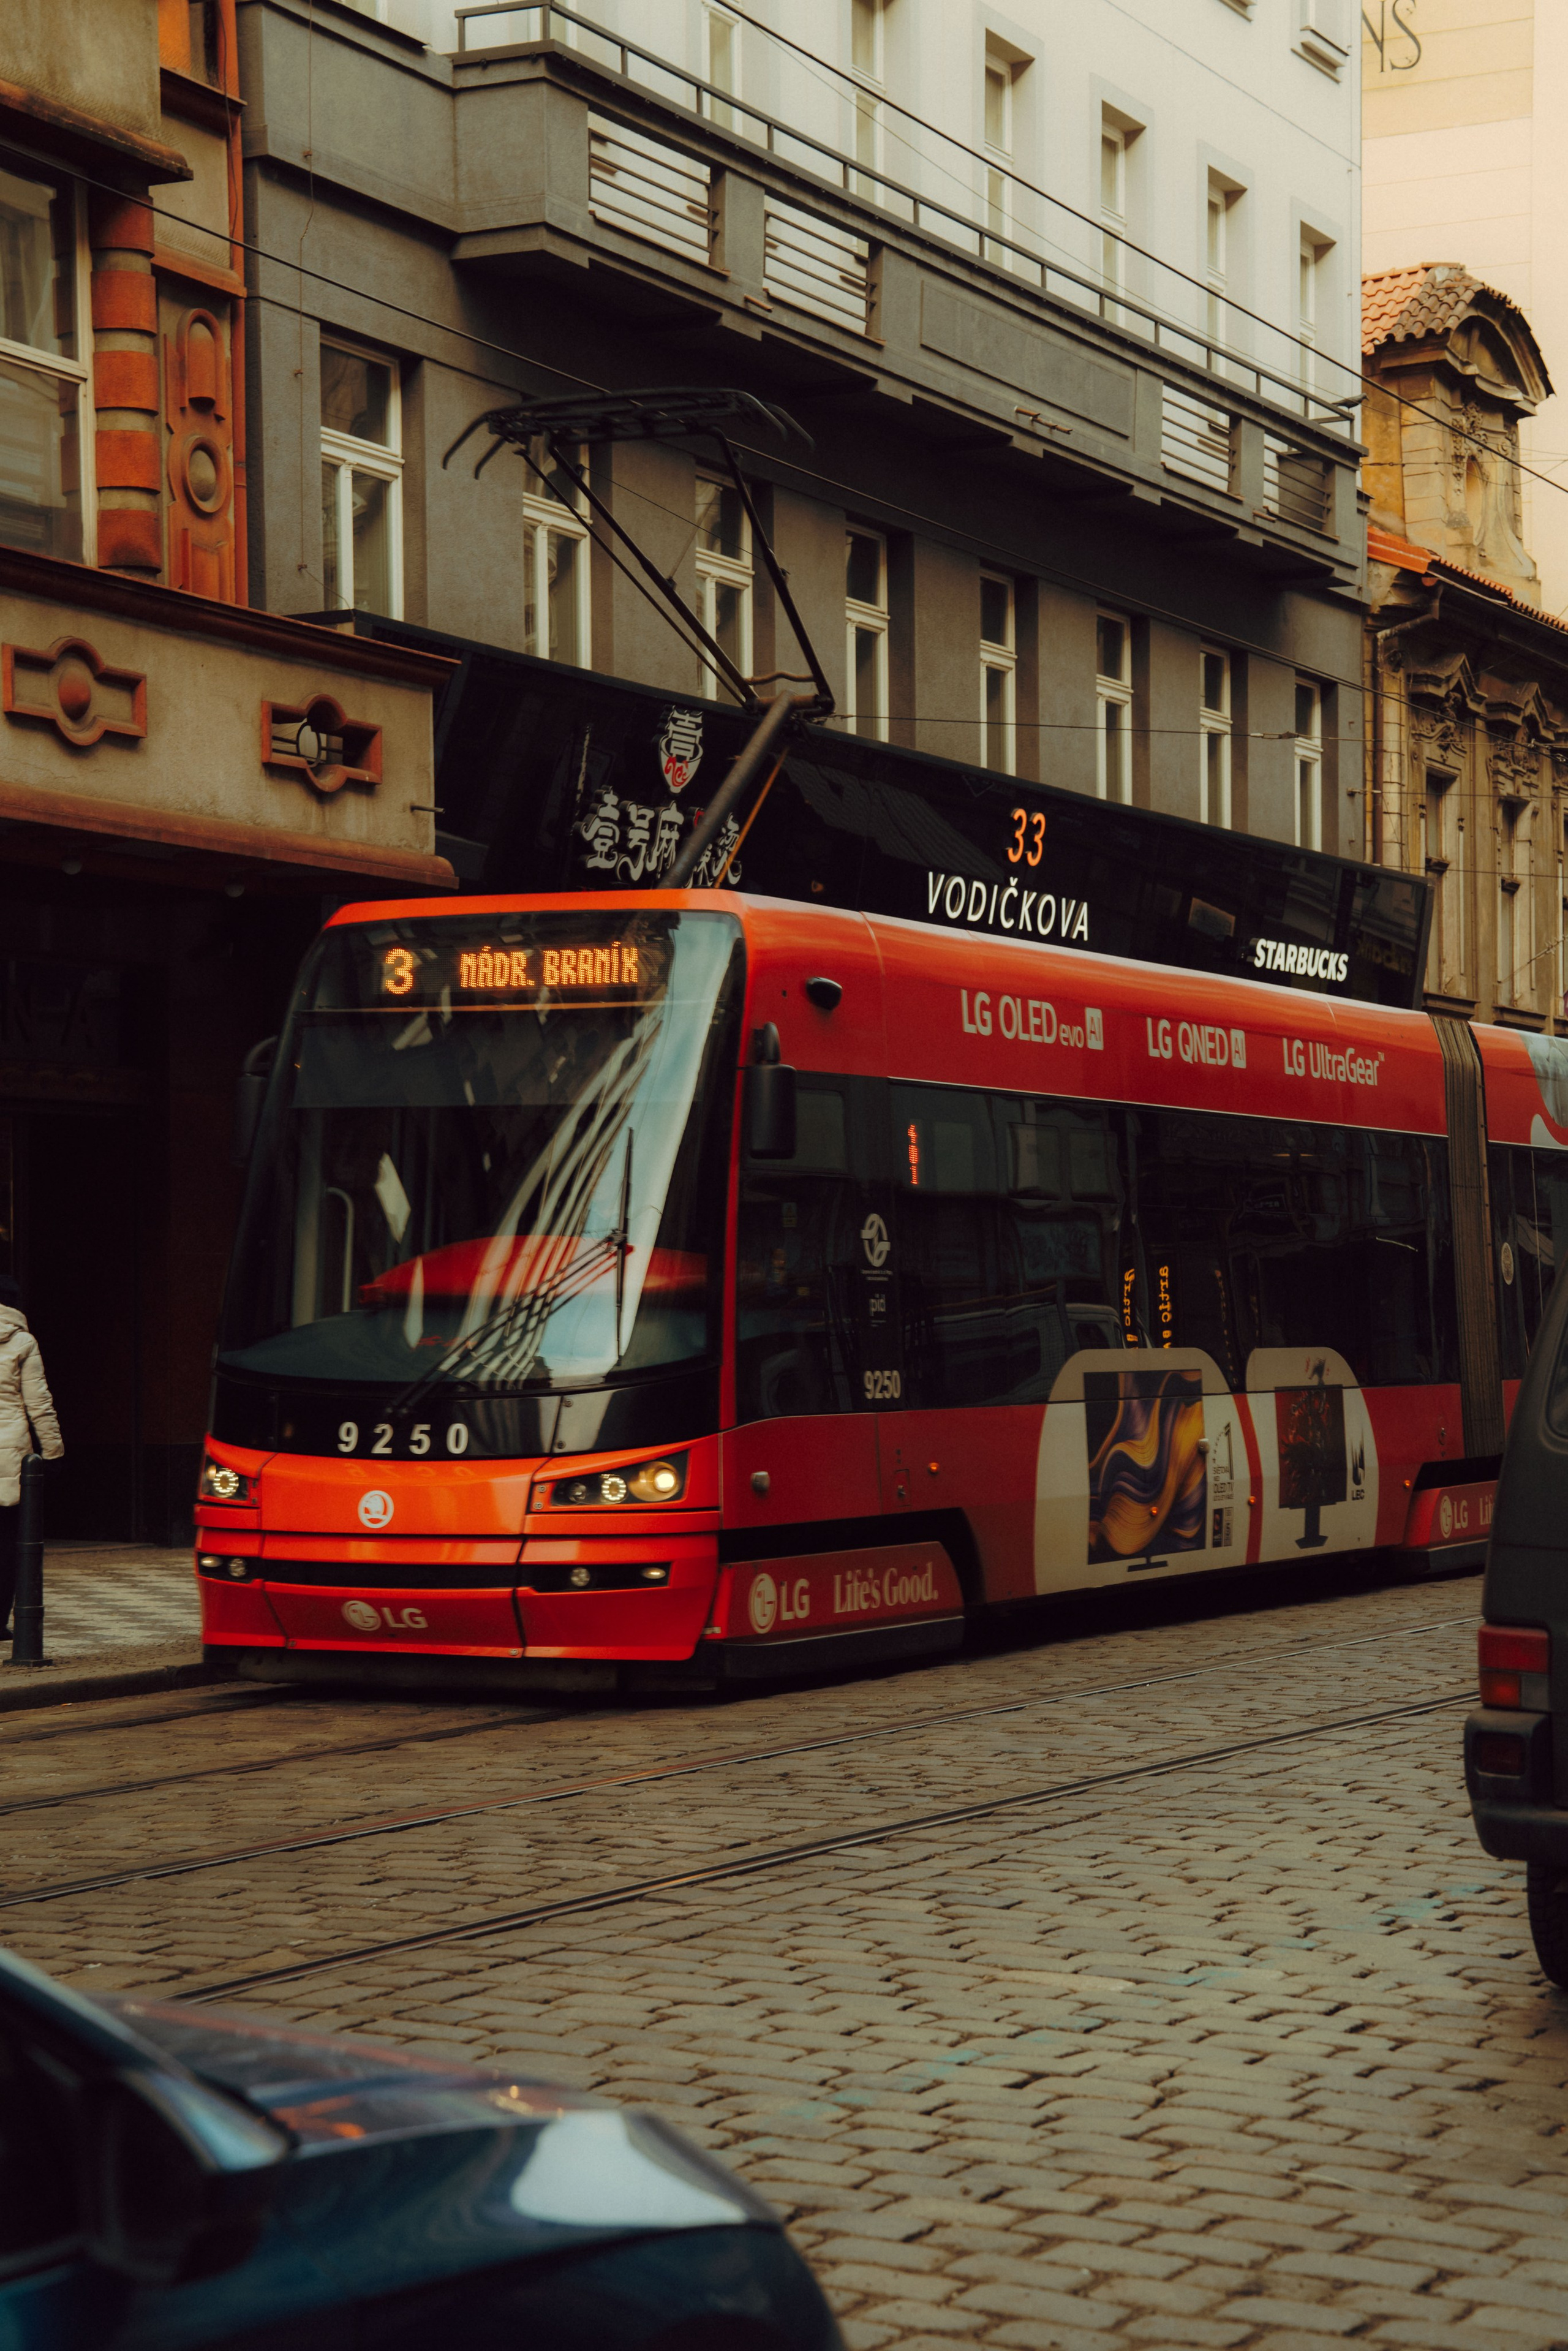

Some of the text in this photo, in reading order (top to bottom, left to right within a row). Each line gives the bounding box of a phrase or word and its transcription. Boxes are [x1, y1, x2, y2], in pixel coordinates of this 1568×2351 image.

[1006, 808, 1046, 866] 33
[928, 871, 1088, 941] VODIČKOVA
[385, 941, 638, 994] 3 NÁDR. BRANÍK
[1254, 938, 1348, 982] STARBUCKS
[960, 989, 992, 1036] LG
[1146, 1017, 1173, 1060] LG
[1177, 1021, 1229, 1066] QNED
[1283, 1037, 1305, 1077] LG
[864, 1370, 902, 1400] 9250
[337, 1421, 469, 1455] 9250
[1351, 1489, 1365, 1501] LEC
[1453, 1500, 1468, 1529] LG
[780, 1562, 938, 1620] LG Life's Good.
[382, 1607, 429, 1629] LG
